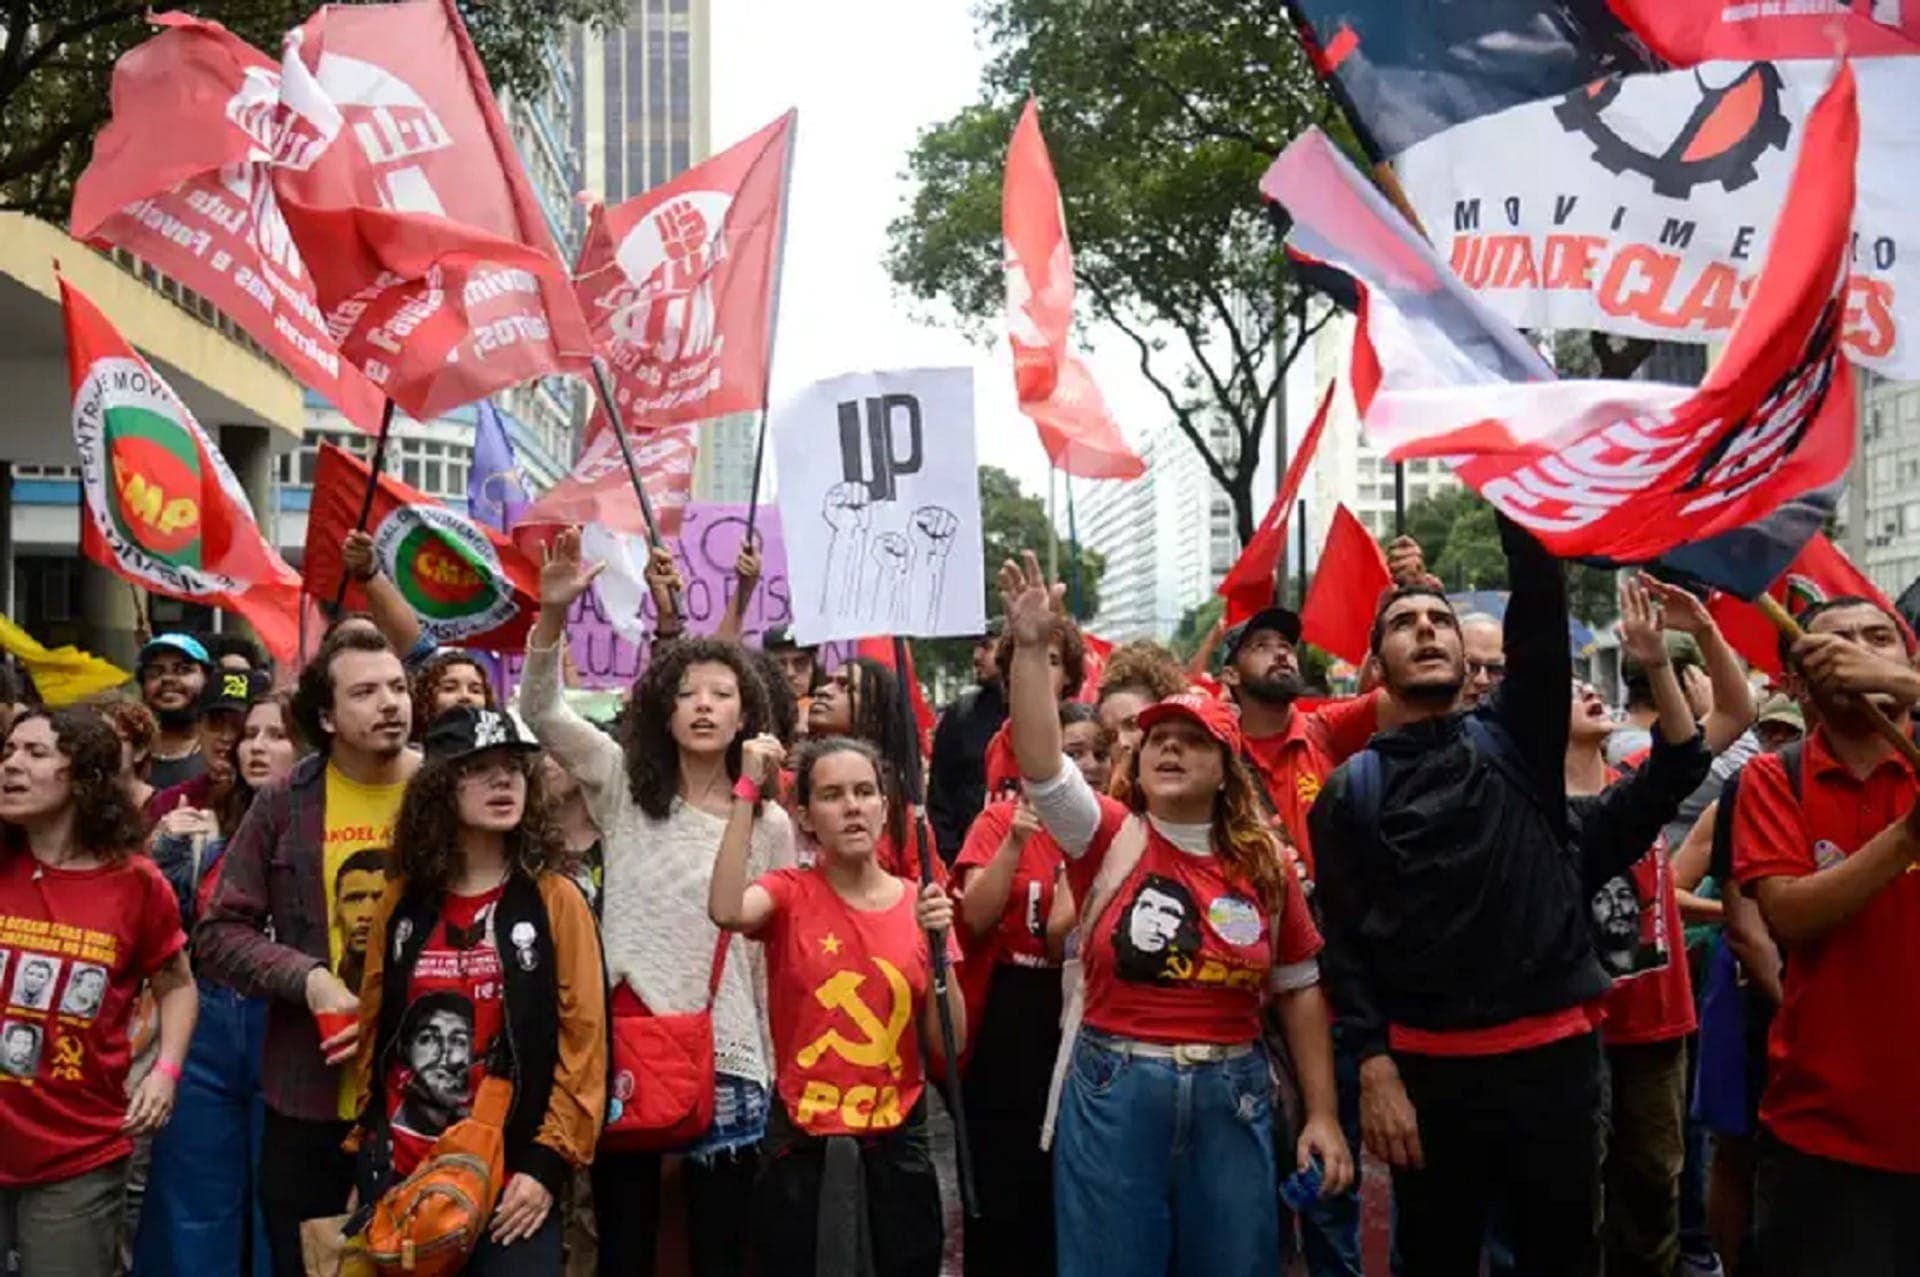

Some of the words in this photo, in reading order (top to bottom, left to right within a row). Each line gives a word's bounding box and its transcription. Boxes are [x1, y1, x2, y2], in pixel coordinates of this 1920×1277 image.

[1454, 194, 1896, 270] MOVIMEO
[1597, 243, 1896, 358] CLAES
[837, 393, 923, 501] UP
[121, 472, 198, 536] MP
